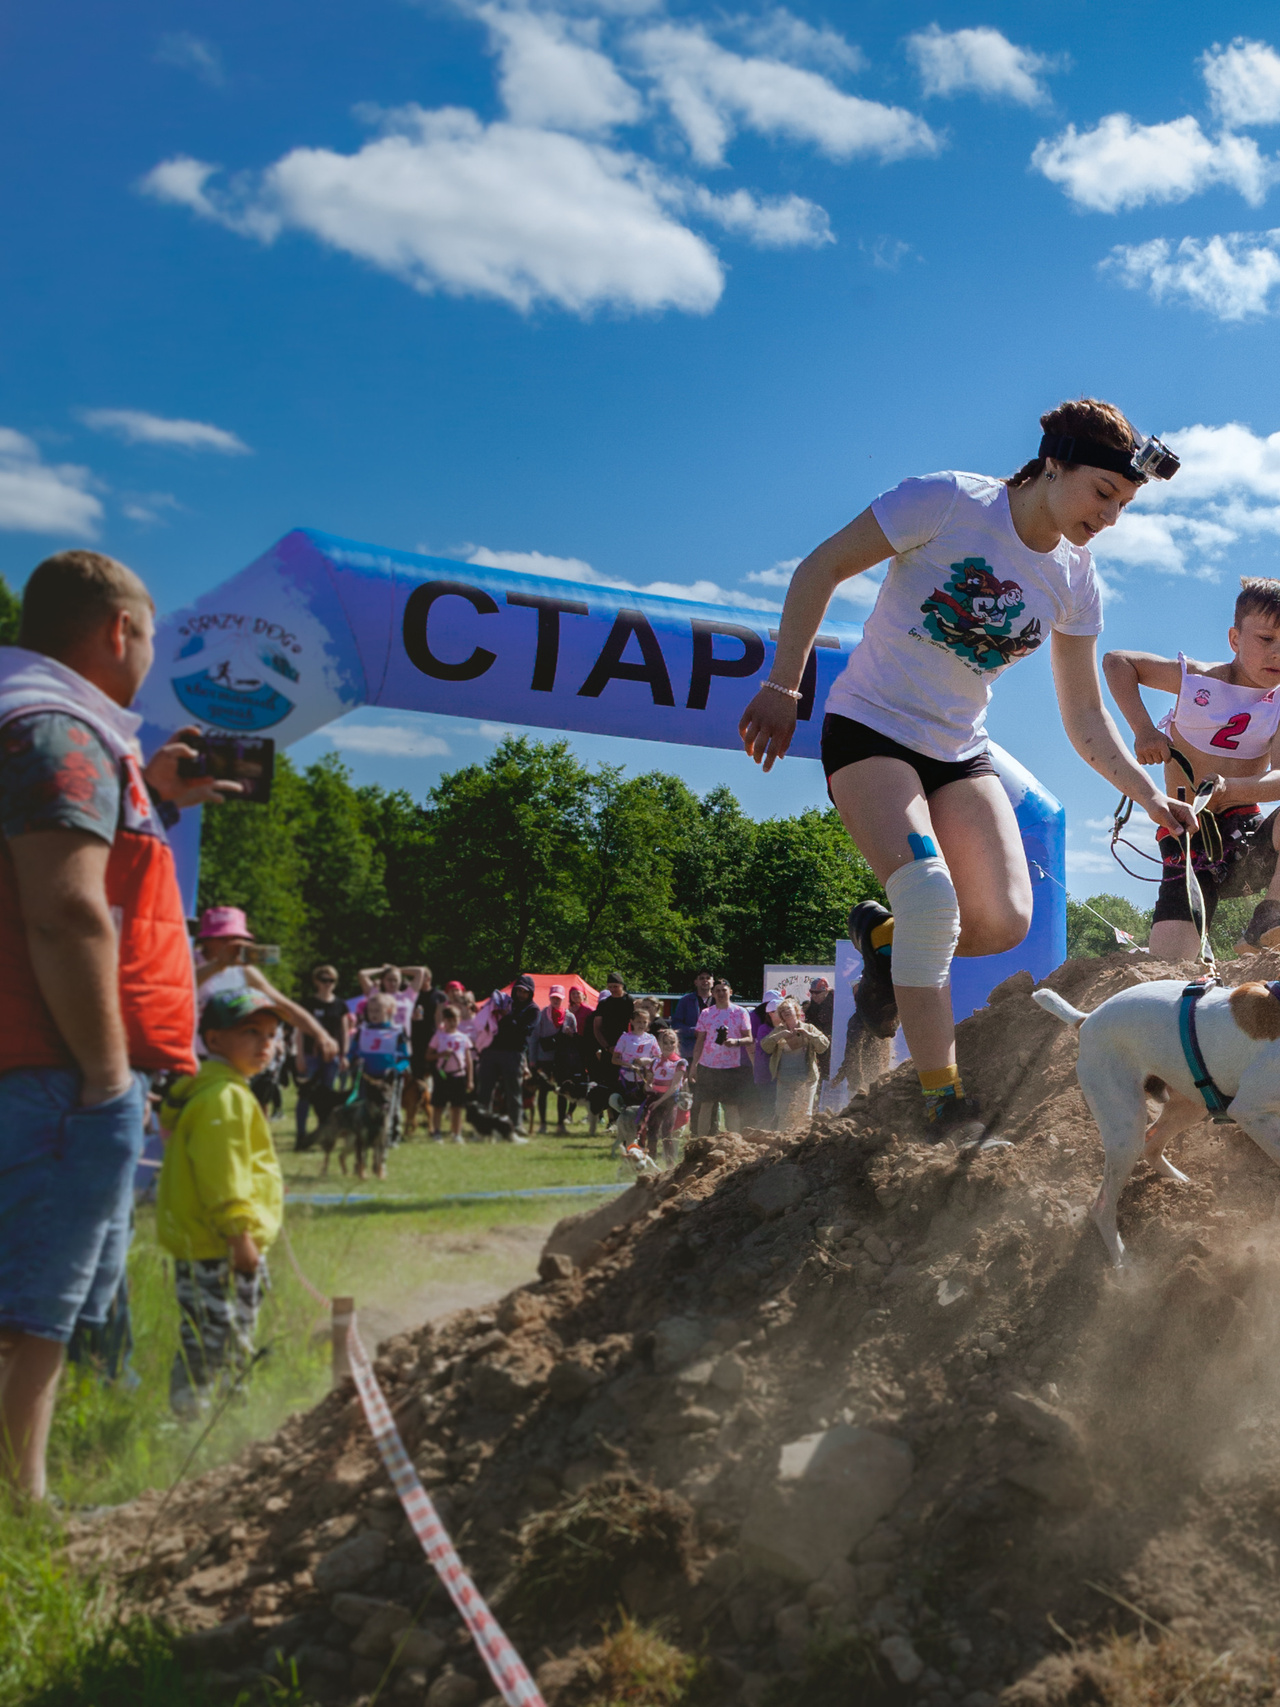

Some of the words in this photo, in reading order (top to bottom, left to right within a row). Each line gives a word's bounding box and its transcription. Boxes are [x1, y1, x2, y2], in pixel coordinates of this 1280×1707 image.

[188, 613, 244, 633] CRAZY
[252, 617, 297, 648] DOG
[1209, 712, 1251, 750] 2
